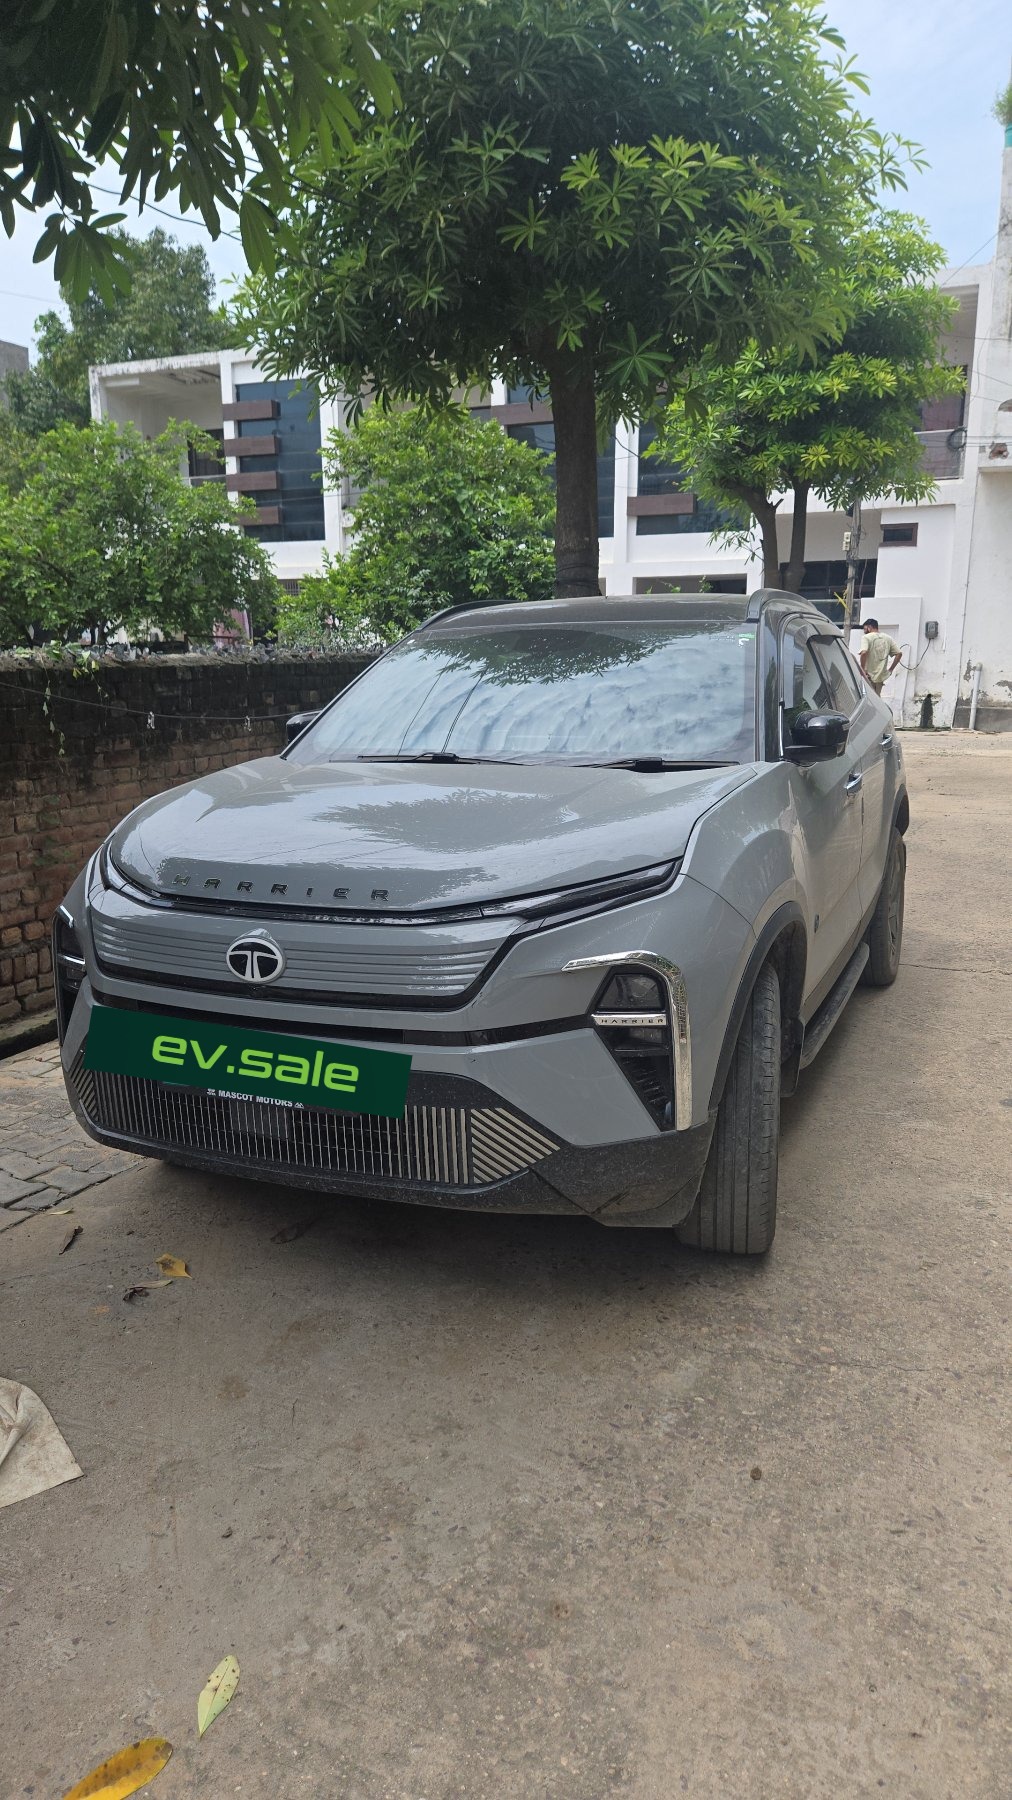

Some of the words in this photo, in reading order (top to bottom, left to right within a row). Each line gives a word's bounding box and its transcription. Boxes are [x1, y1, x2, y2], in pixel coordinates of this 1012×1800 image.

[172, 874, 390, 901] HARRIER
[218, 1089, 254, 1102] MASCOT
[256, 1095, 293, 1108] MOTORS
